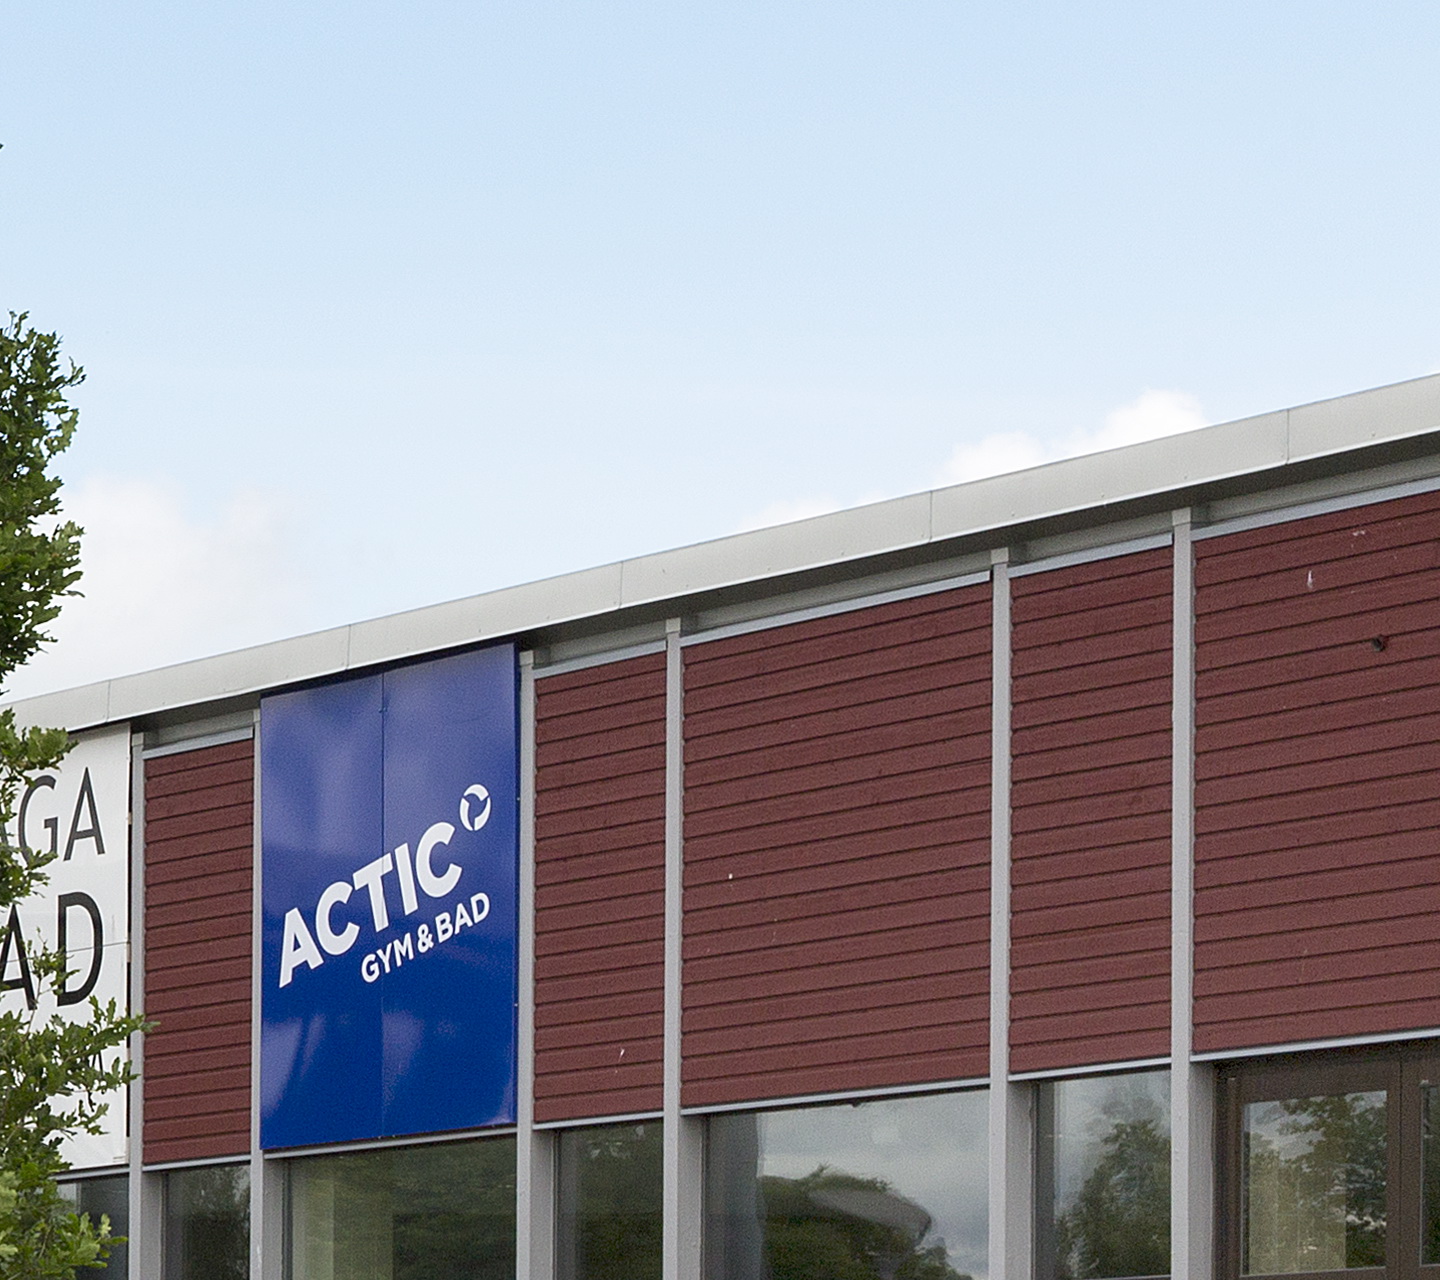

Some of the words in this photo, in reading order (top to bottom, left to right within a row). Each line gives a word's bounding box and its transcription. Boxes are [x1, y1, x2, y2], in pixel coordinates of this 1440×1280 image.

[279, 821, 463, 988] ACTIC
[361, 932, 415, 984] GYM
[417, 923, 435, 954] &
[435, 892, 491, 944] BAD
